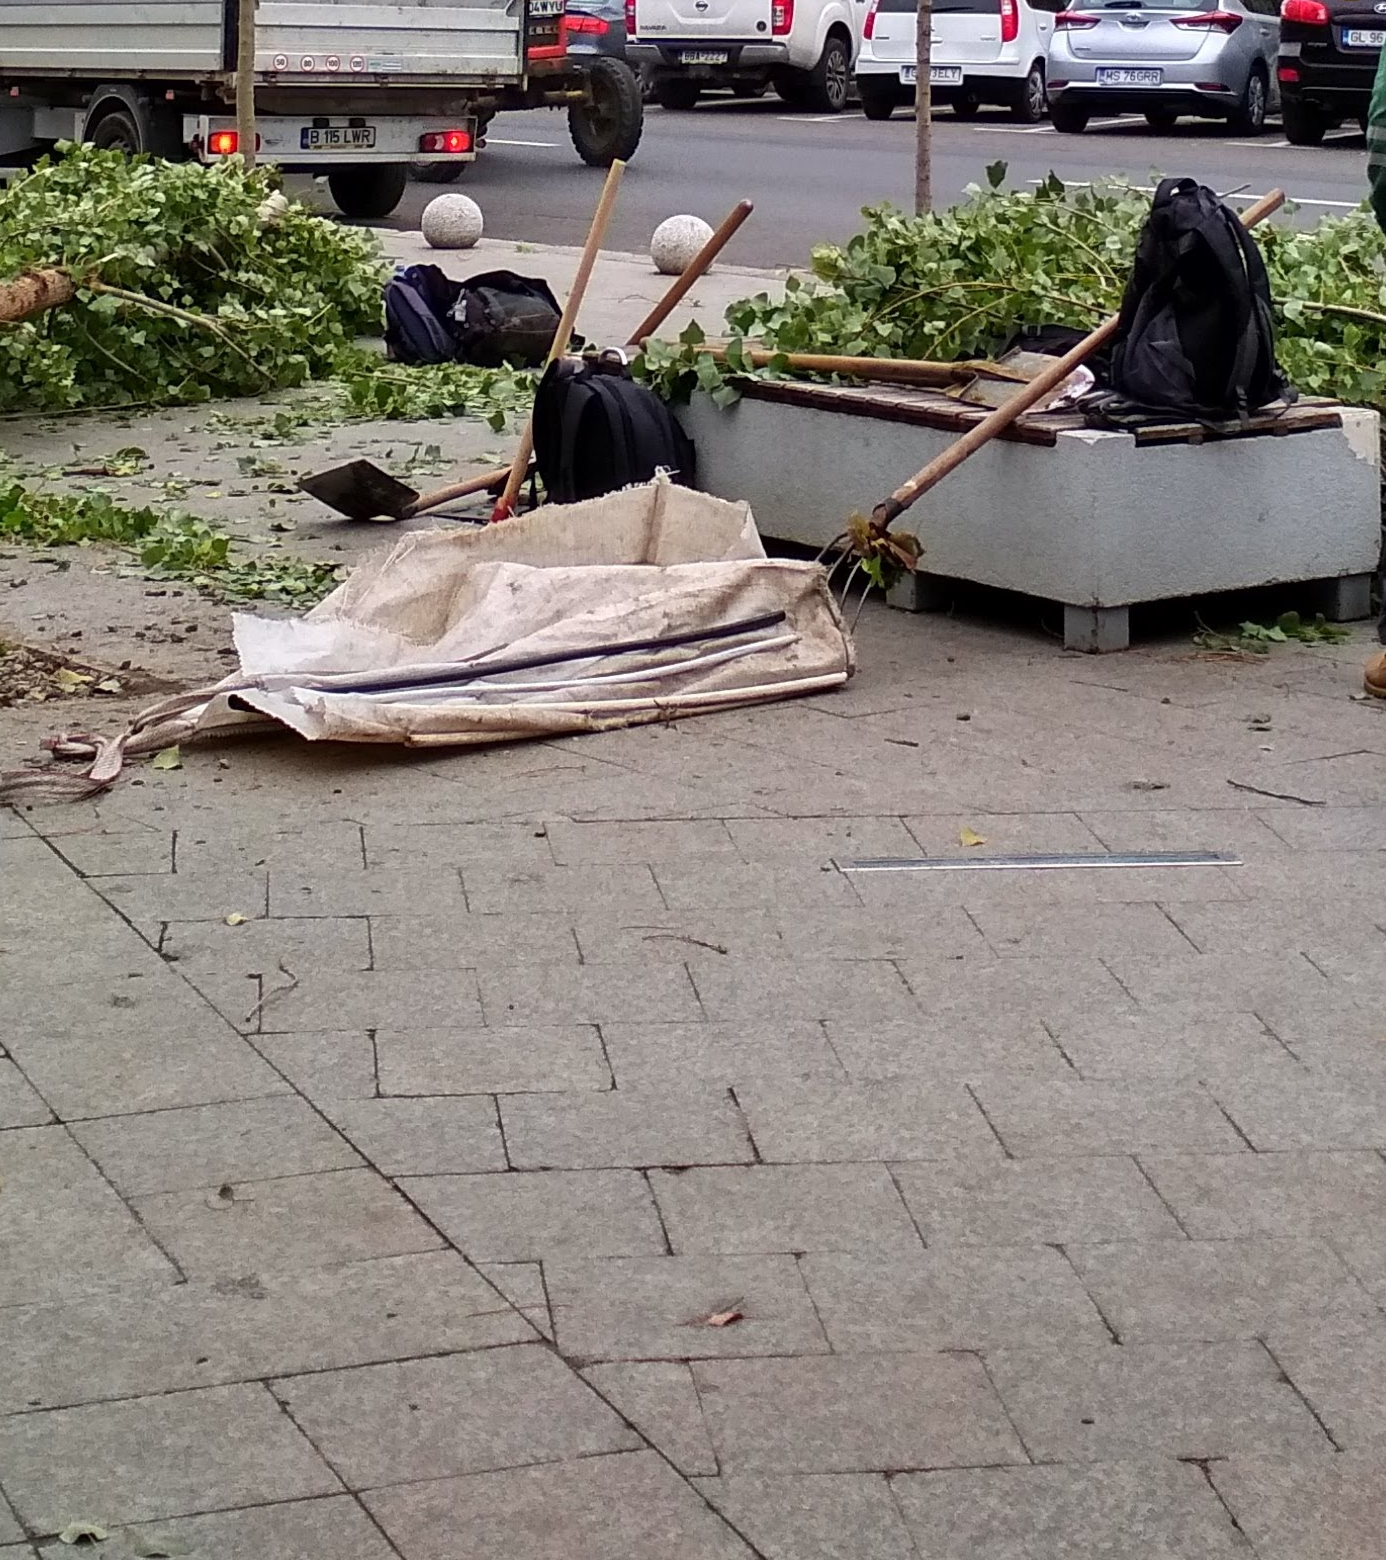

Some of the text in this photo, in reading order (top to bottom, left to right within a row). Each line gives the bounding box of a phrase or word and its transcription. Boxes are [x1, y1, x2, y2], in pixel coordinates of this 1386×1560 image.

[1350, 32, 1383, 43] GL 96
[310, 130, 371, 144] B 115 LWR
